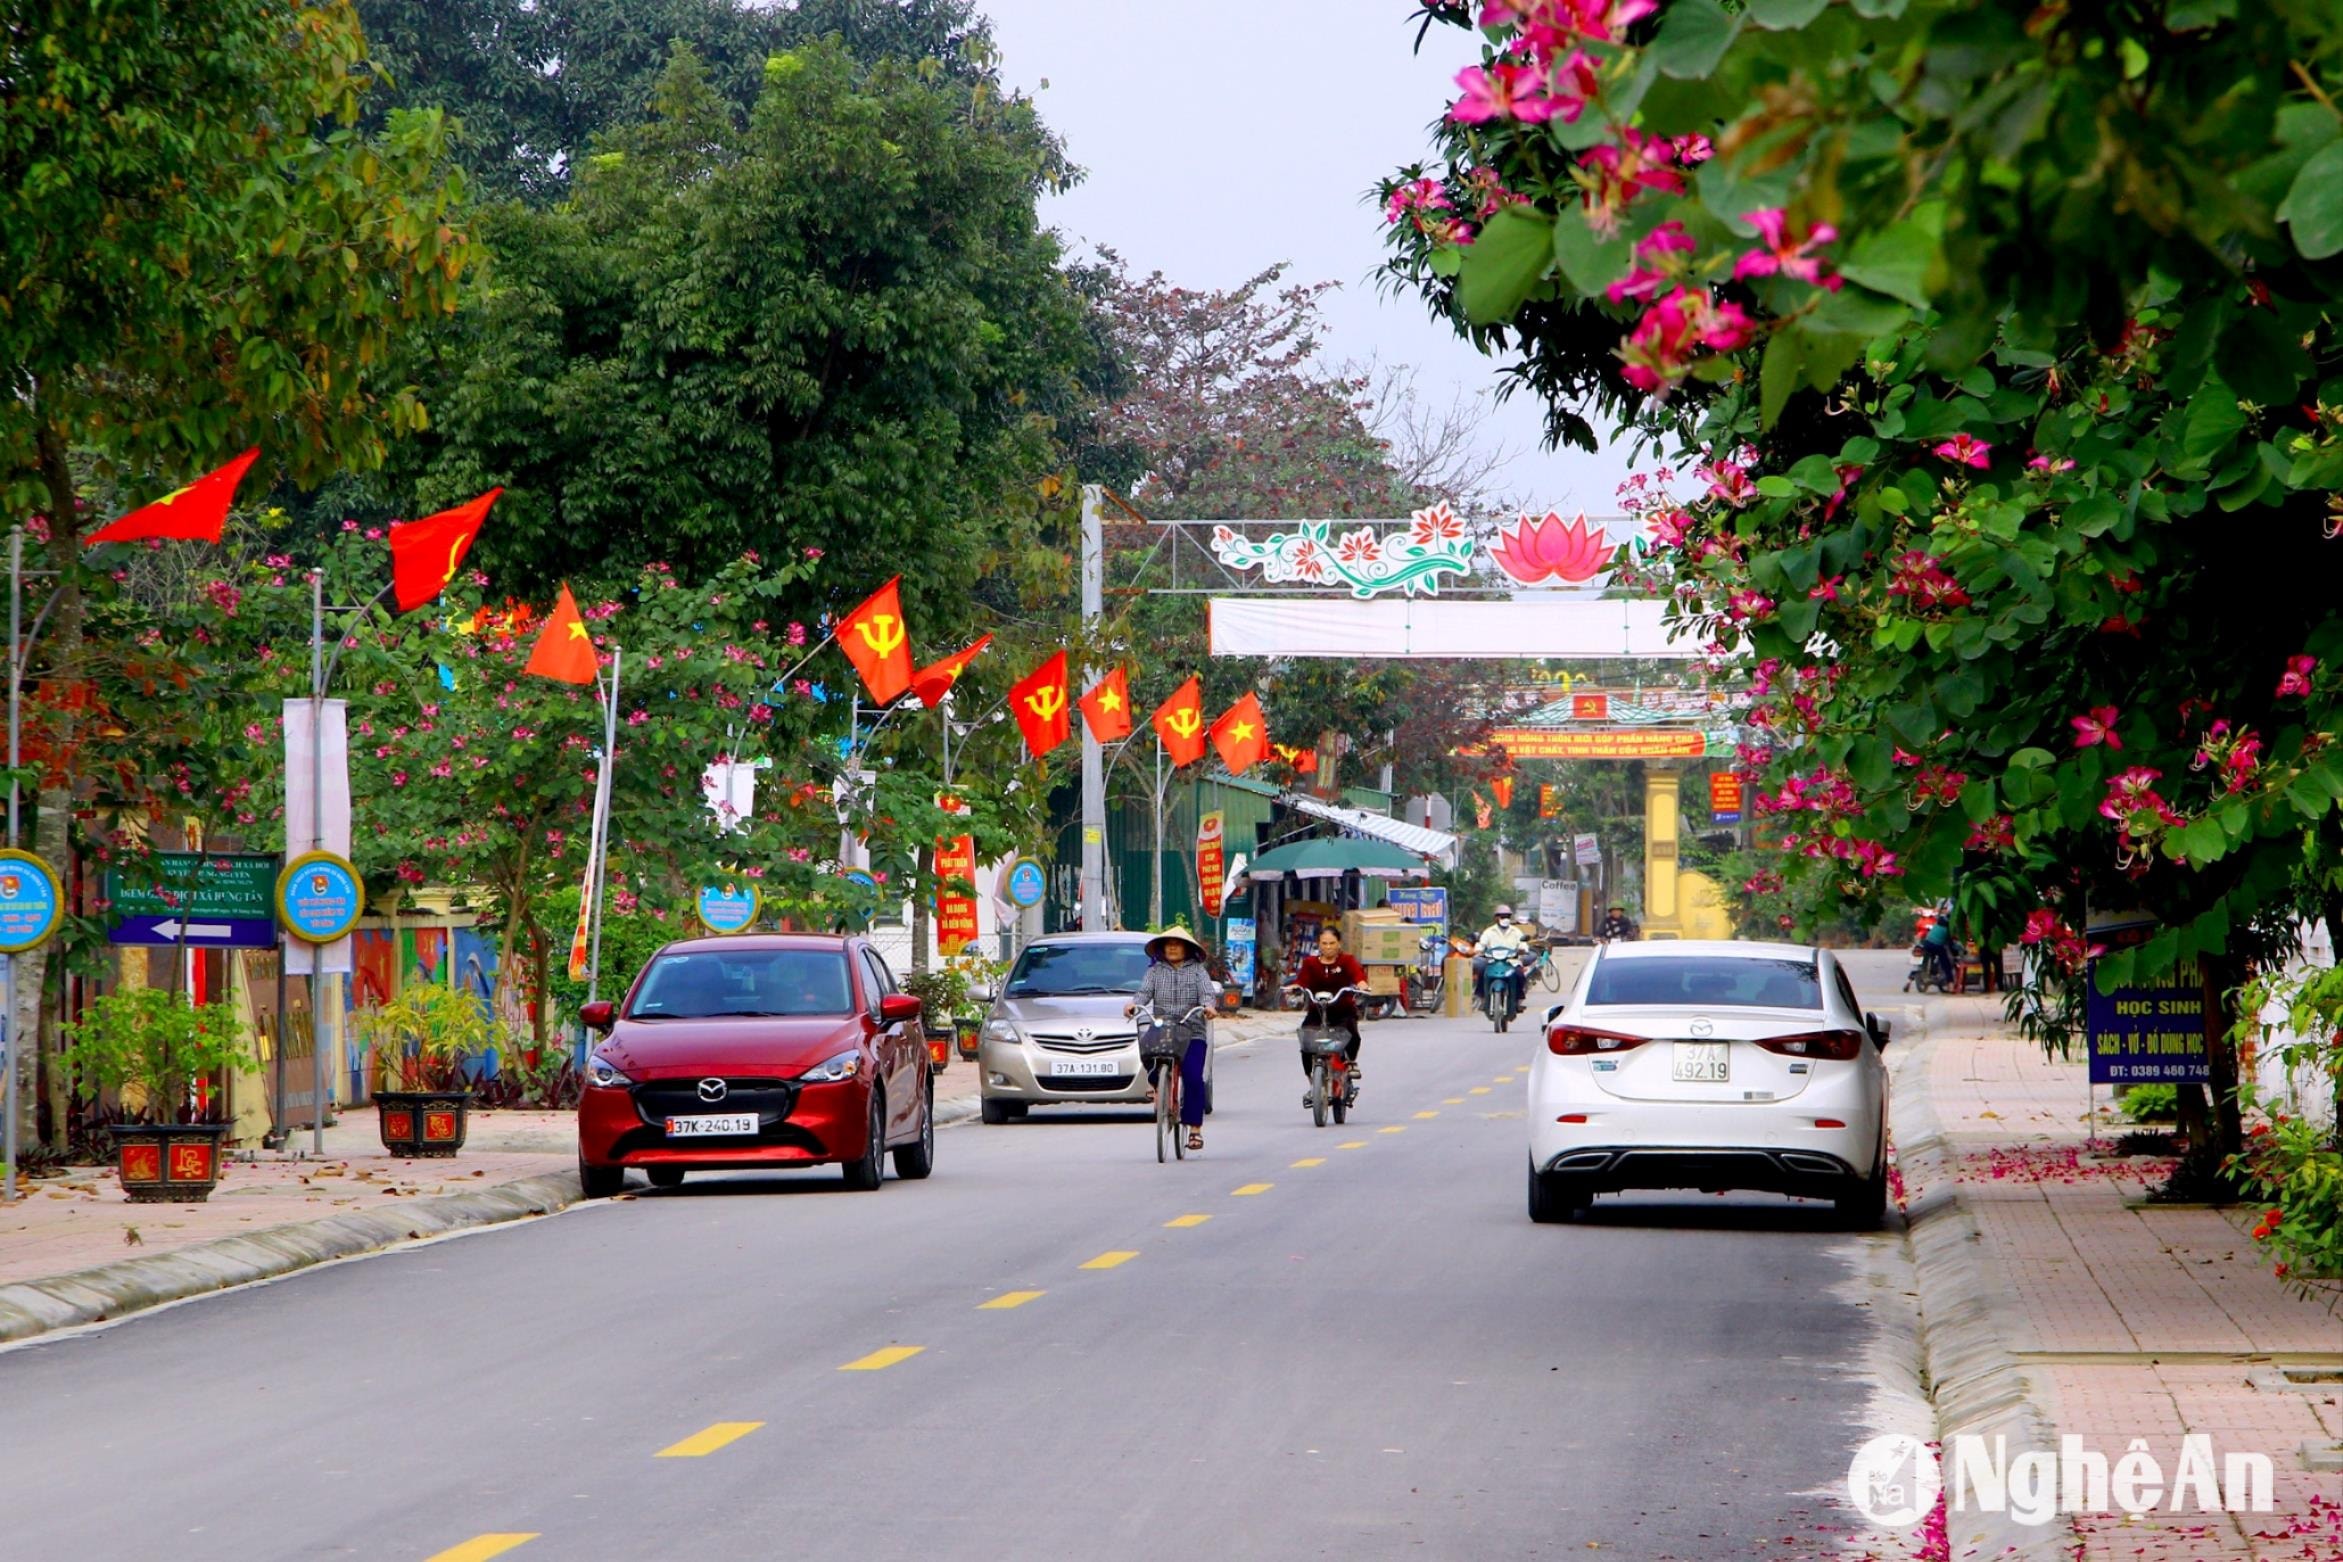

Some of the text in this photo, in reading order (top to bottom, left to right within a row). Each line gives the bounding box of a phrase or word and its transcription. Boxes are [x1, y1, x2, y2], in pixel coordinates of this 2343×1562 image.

[1541, 880, 1576, 891] Coffee
[2116, 1001, 2201, 1018] HỌC SINH
[2096, 1028, 2120, 1055] SÁCH
[2128, 1024, 2140, 1055] VỞ
[2186, 1033, 2204, 1059] HỌC
[1675, 1062, 1727, 1079] 492.19
[2109, 1065, 2128, 1077] ĐT:
[2131, 1065, 2160, 1077] 0389
